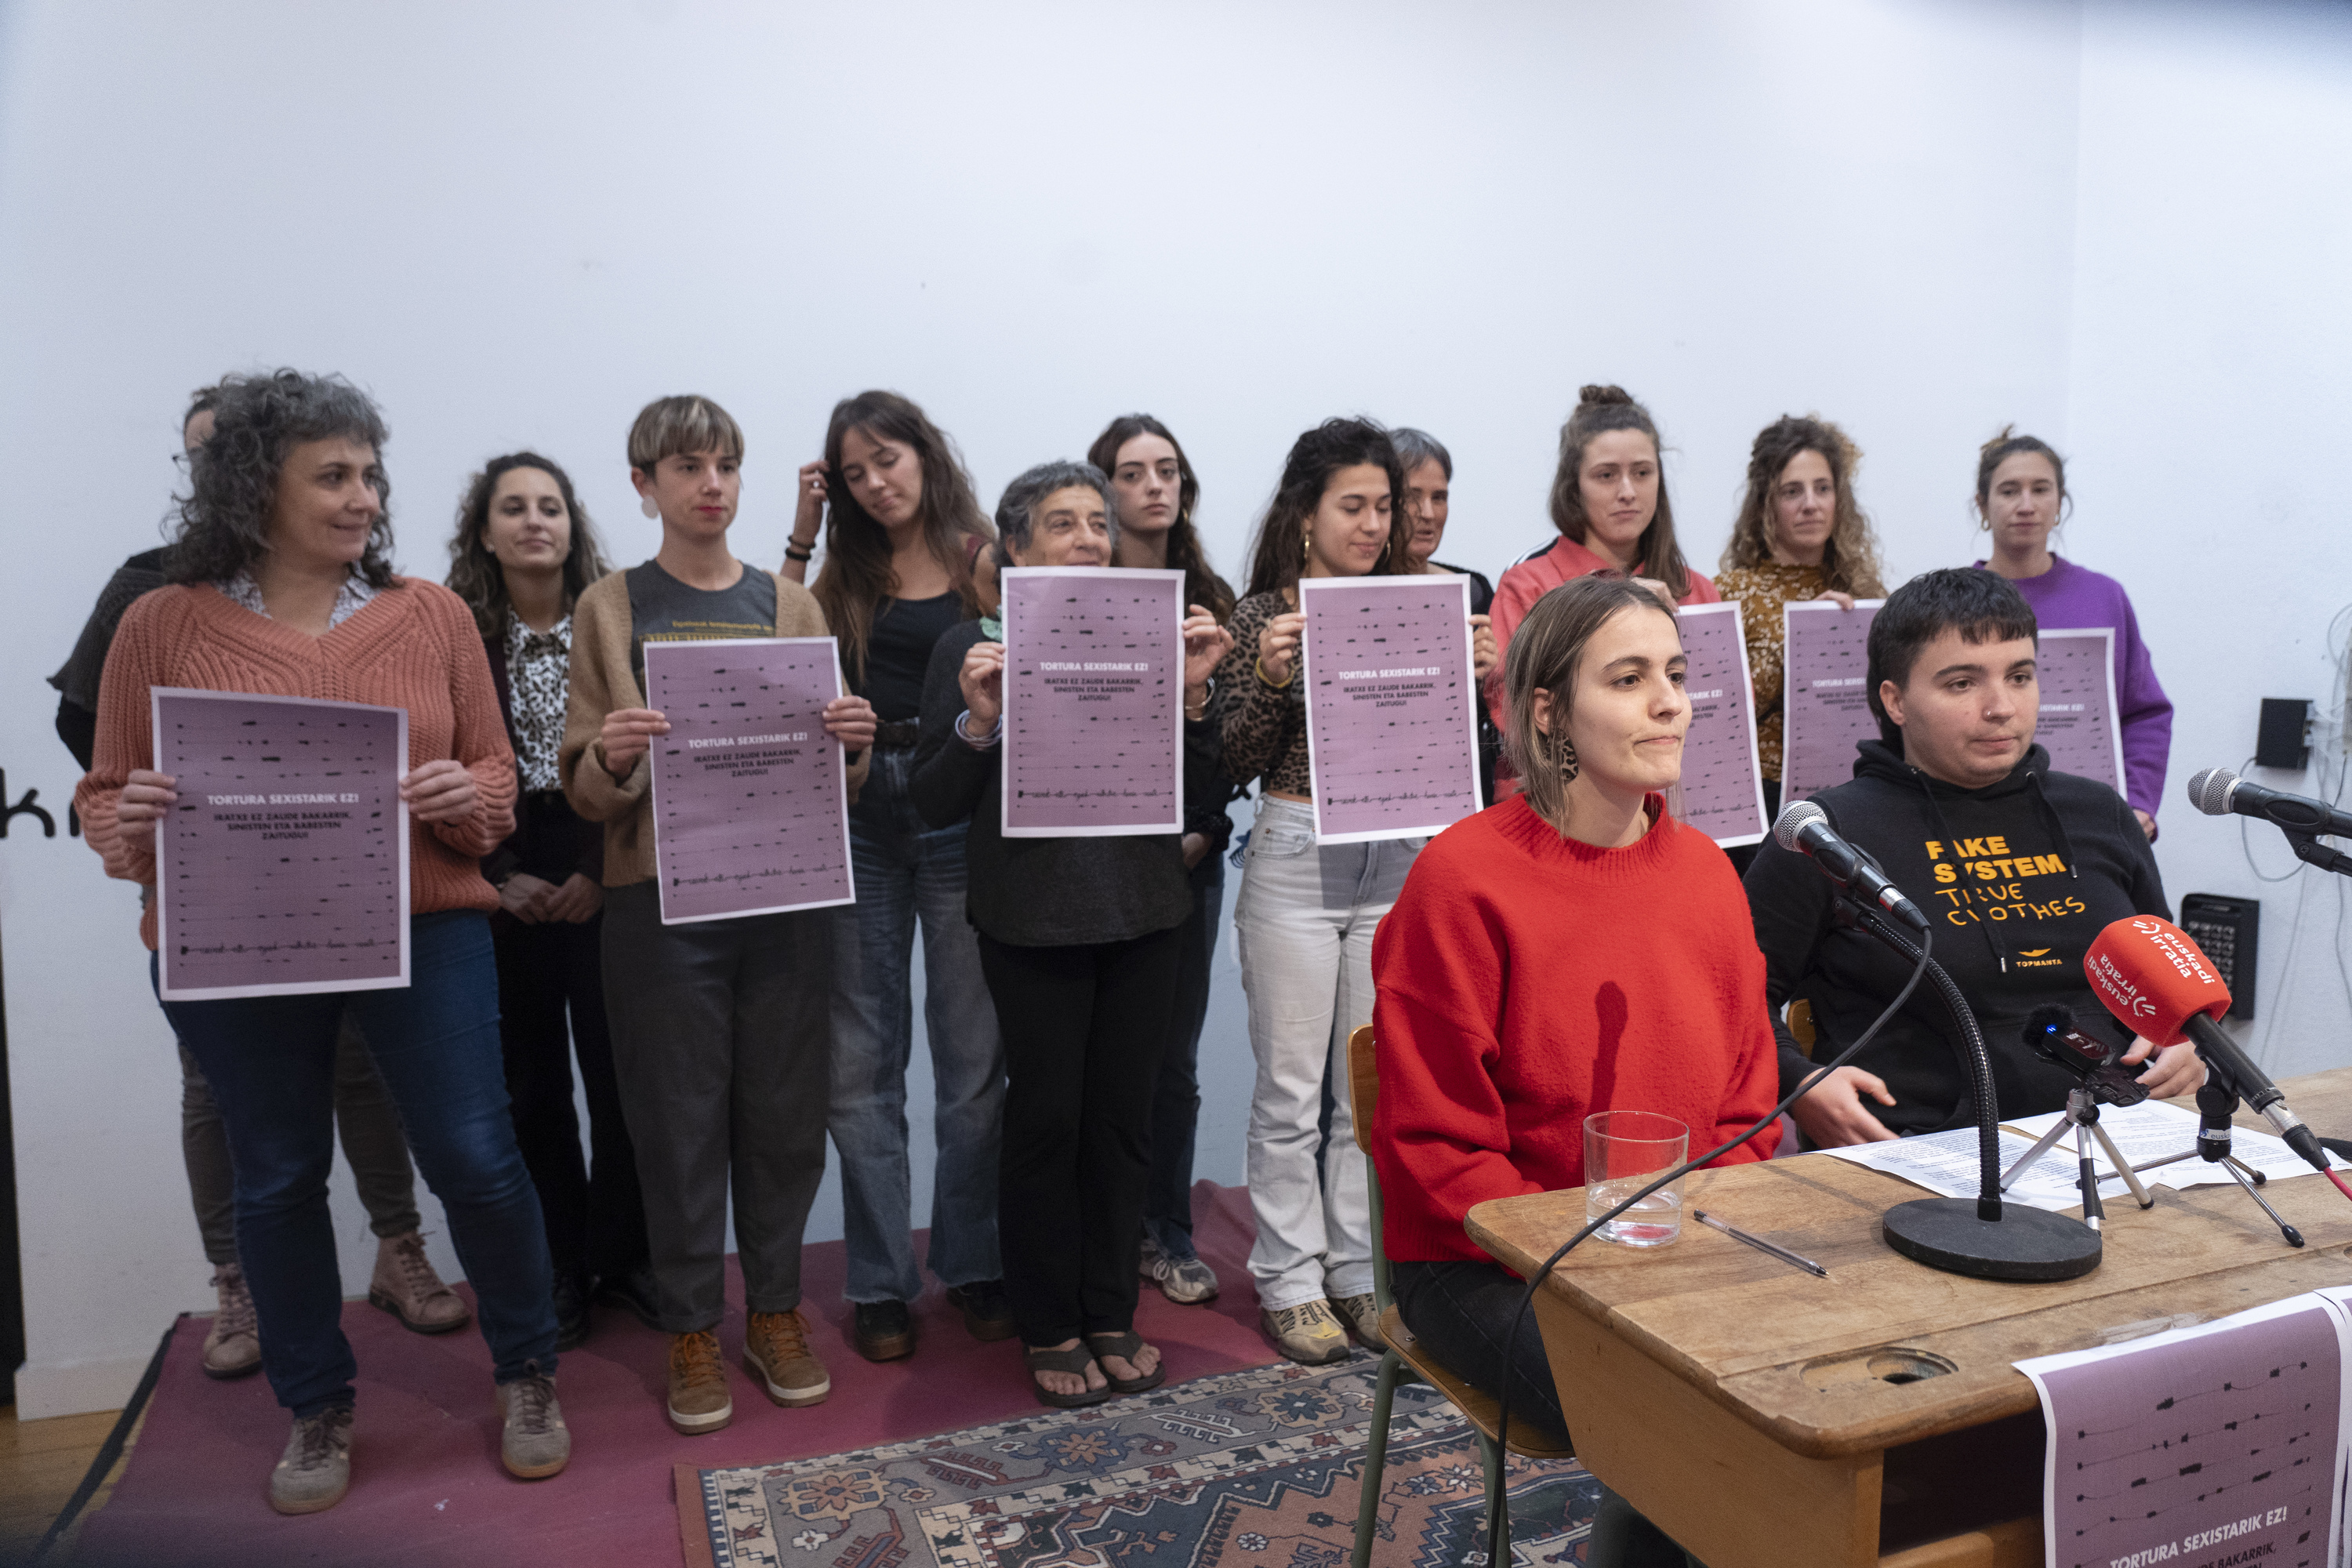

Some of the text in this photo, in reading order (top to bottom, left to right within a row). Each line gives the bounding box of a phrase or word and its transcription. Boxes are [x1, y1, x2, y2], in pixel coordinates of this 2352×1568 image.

[1083, 662, 1132, 671] SEXISTARIK
[1339, 670, 1377, 680] TORTURA
[1380, 667, 1425, 678] SEXISTARIK
[688, 738, 735, 749] TORTURA
[737, 733, 790, 745] SEXISTARIK
[207, 794, 266, 805] TORTURA
[269, 793, 337, 804] SEXISTARIK
[1933, 854, 2067, 883] SSTEM
[2016, 959, 2063, 967] TOPMANTA
[2150, 934, 2192, 978] irratia
[2164, 932, 2215, 984] euskadi
[2087, 956, 2129, 1006] euskadi
[2100, 953, 2137, 1000] irratia
[2110, 1506, 2287, 1568] TORTURA SEXISTARIK EZ!
